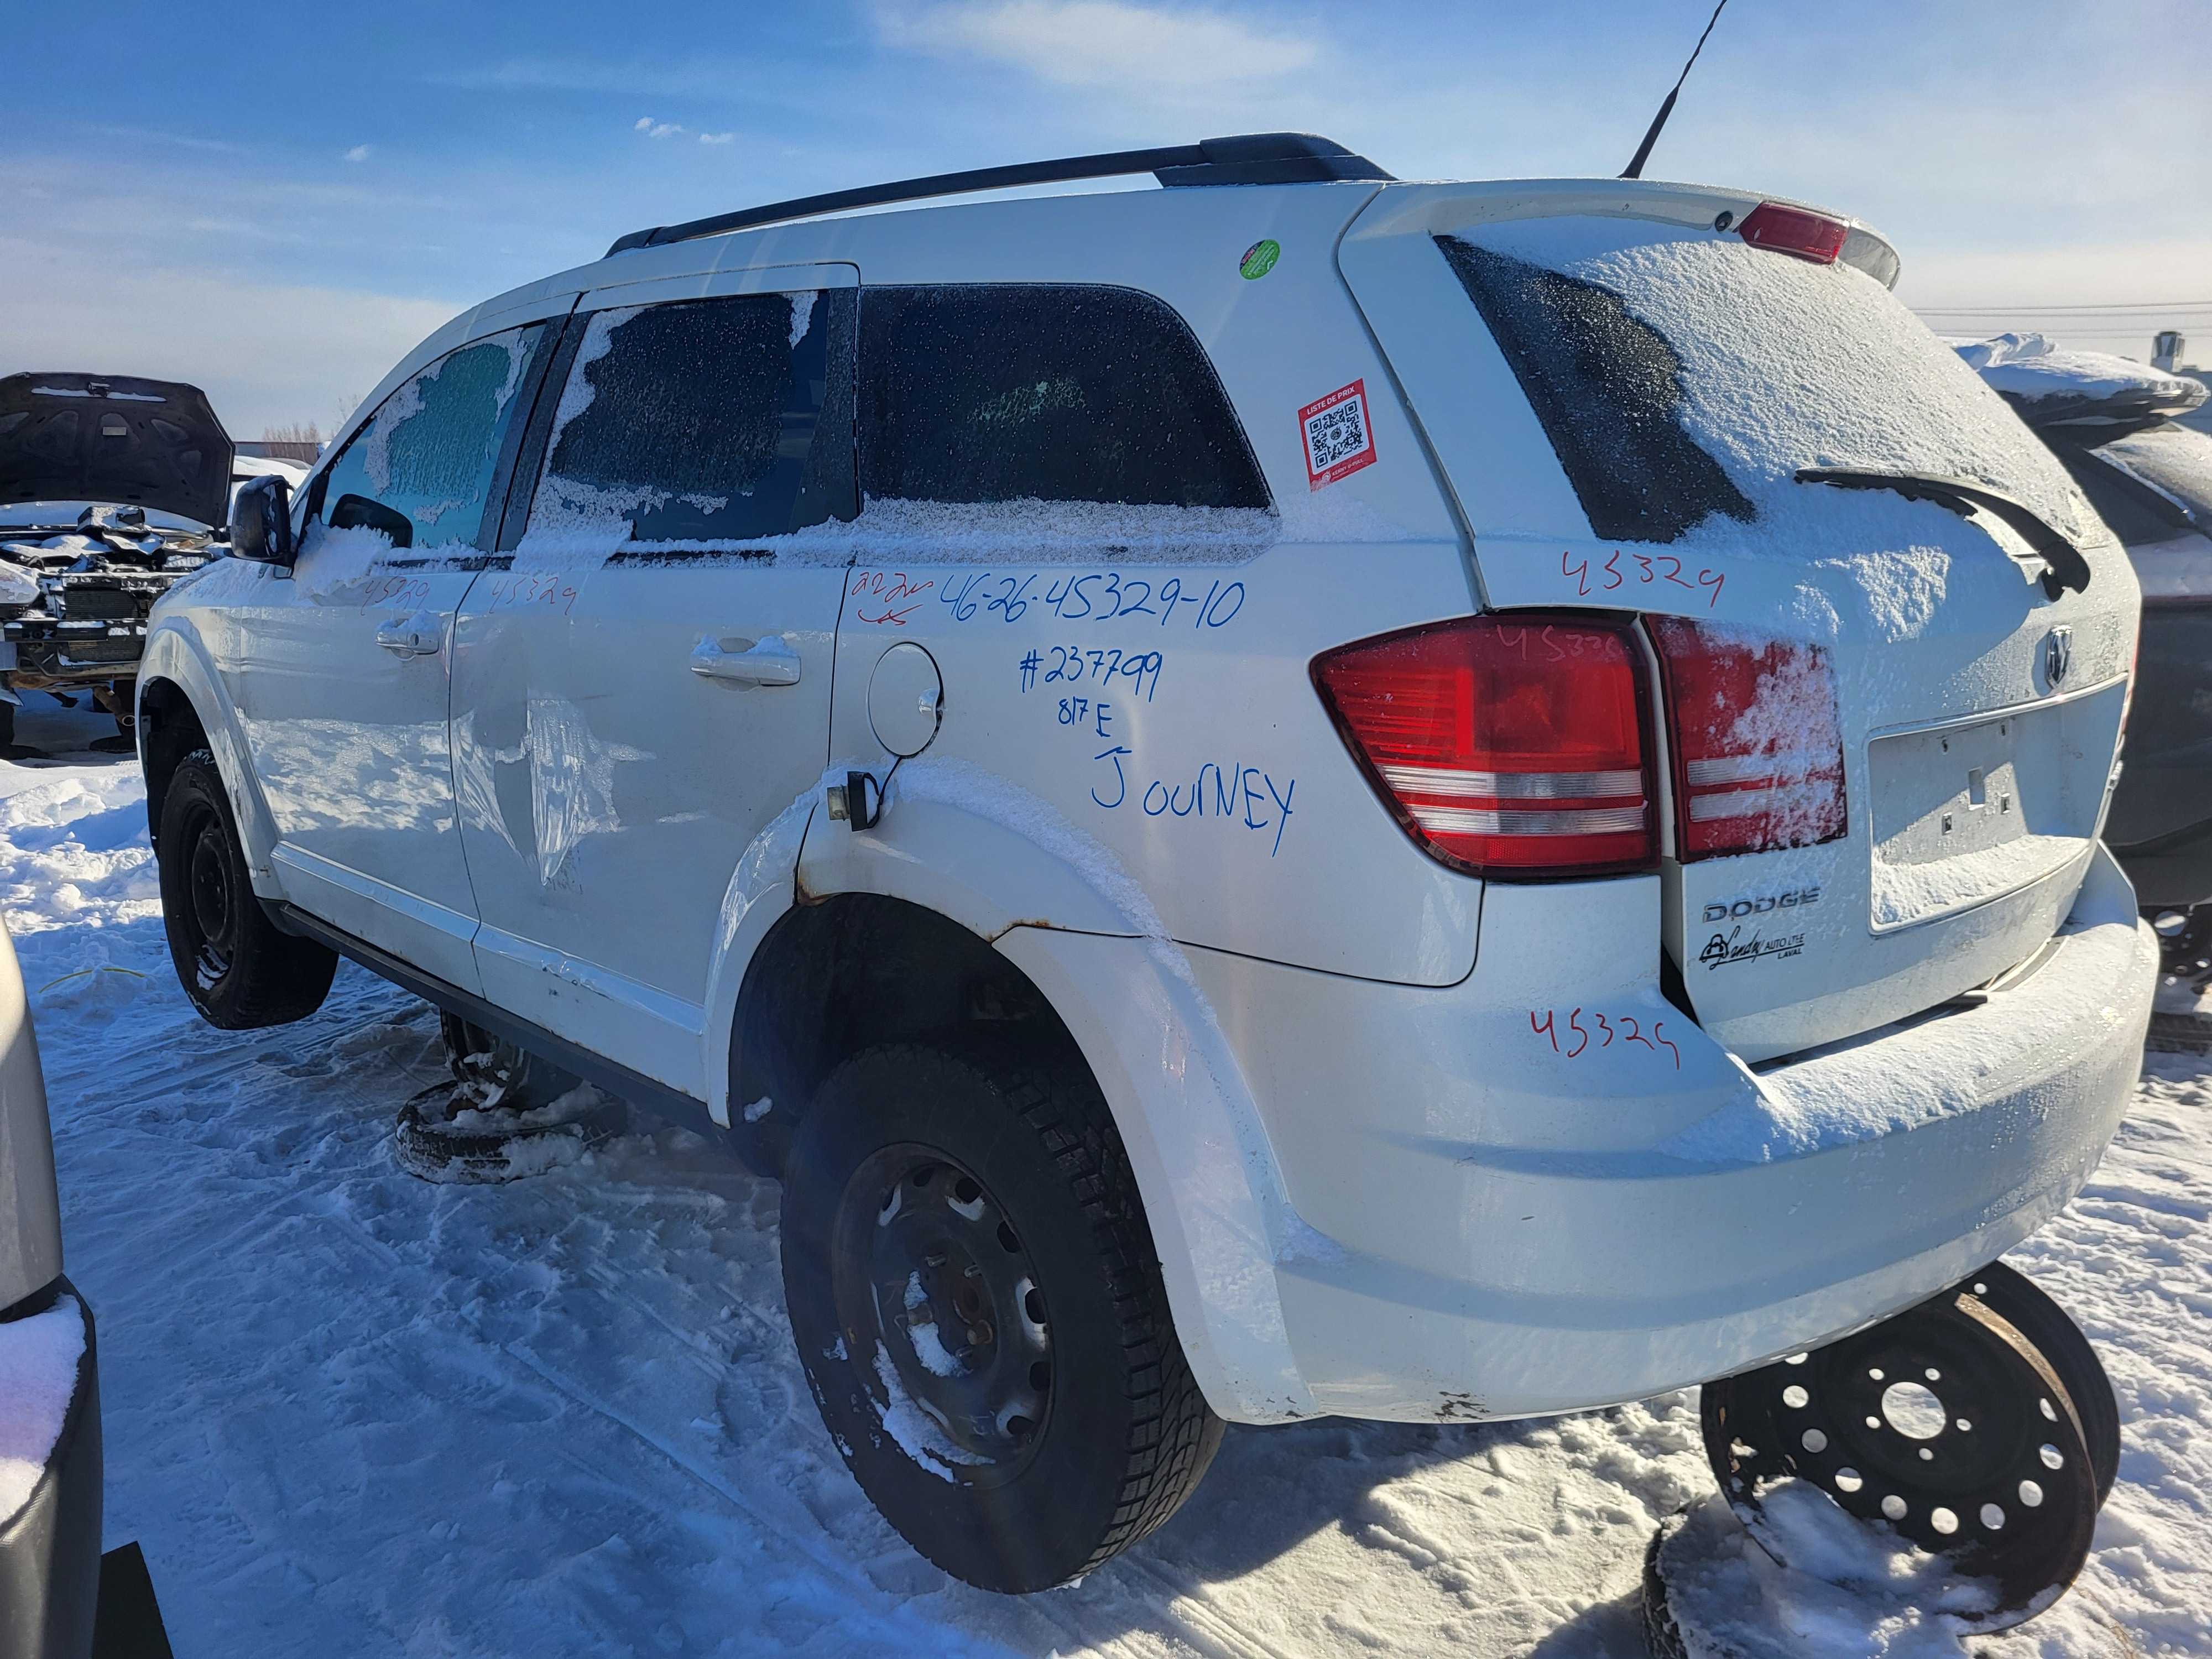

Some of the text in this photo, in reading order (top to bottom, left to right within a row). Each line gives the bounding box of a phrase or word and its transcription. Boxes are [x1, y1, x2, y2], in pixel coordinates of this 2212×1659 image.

[1307, 386, 1355, 415] LISTE DE PRIX
[361, 575, 430, 616] 45329
[488, 576, 577, 616] 45329
[1563, 550, 1725, 608] 45329
[1019, 645, 1163, 702] #237799
[1703, 886, 1821, 923] DODGE
[1765, 937, 1787, 951] AUTO
[1777, 947, 1803, 959] LAVAL
[1530, 1007, 1679, 1070] 45329
